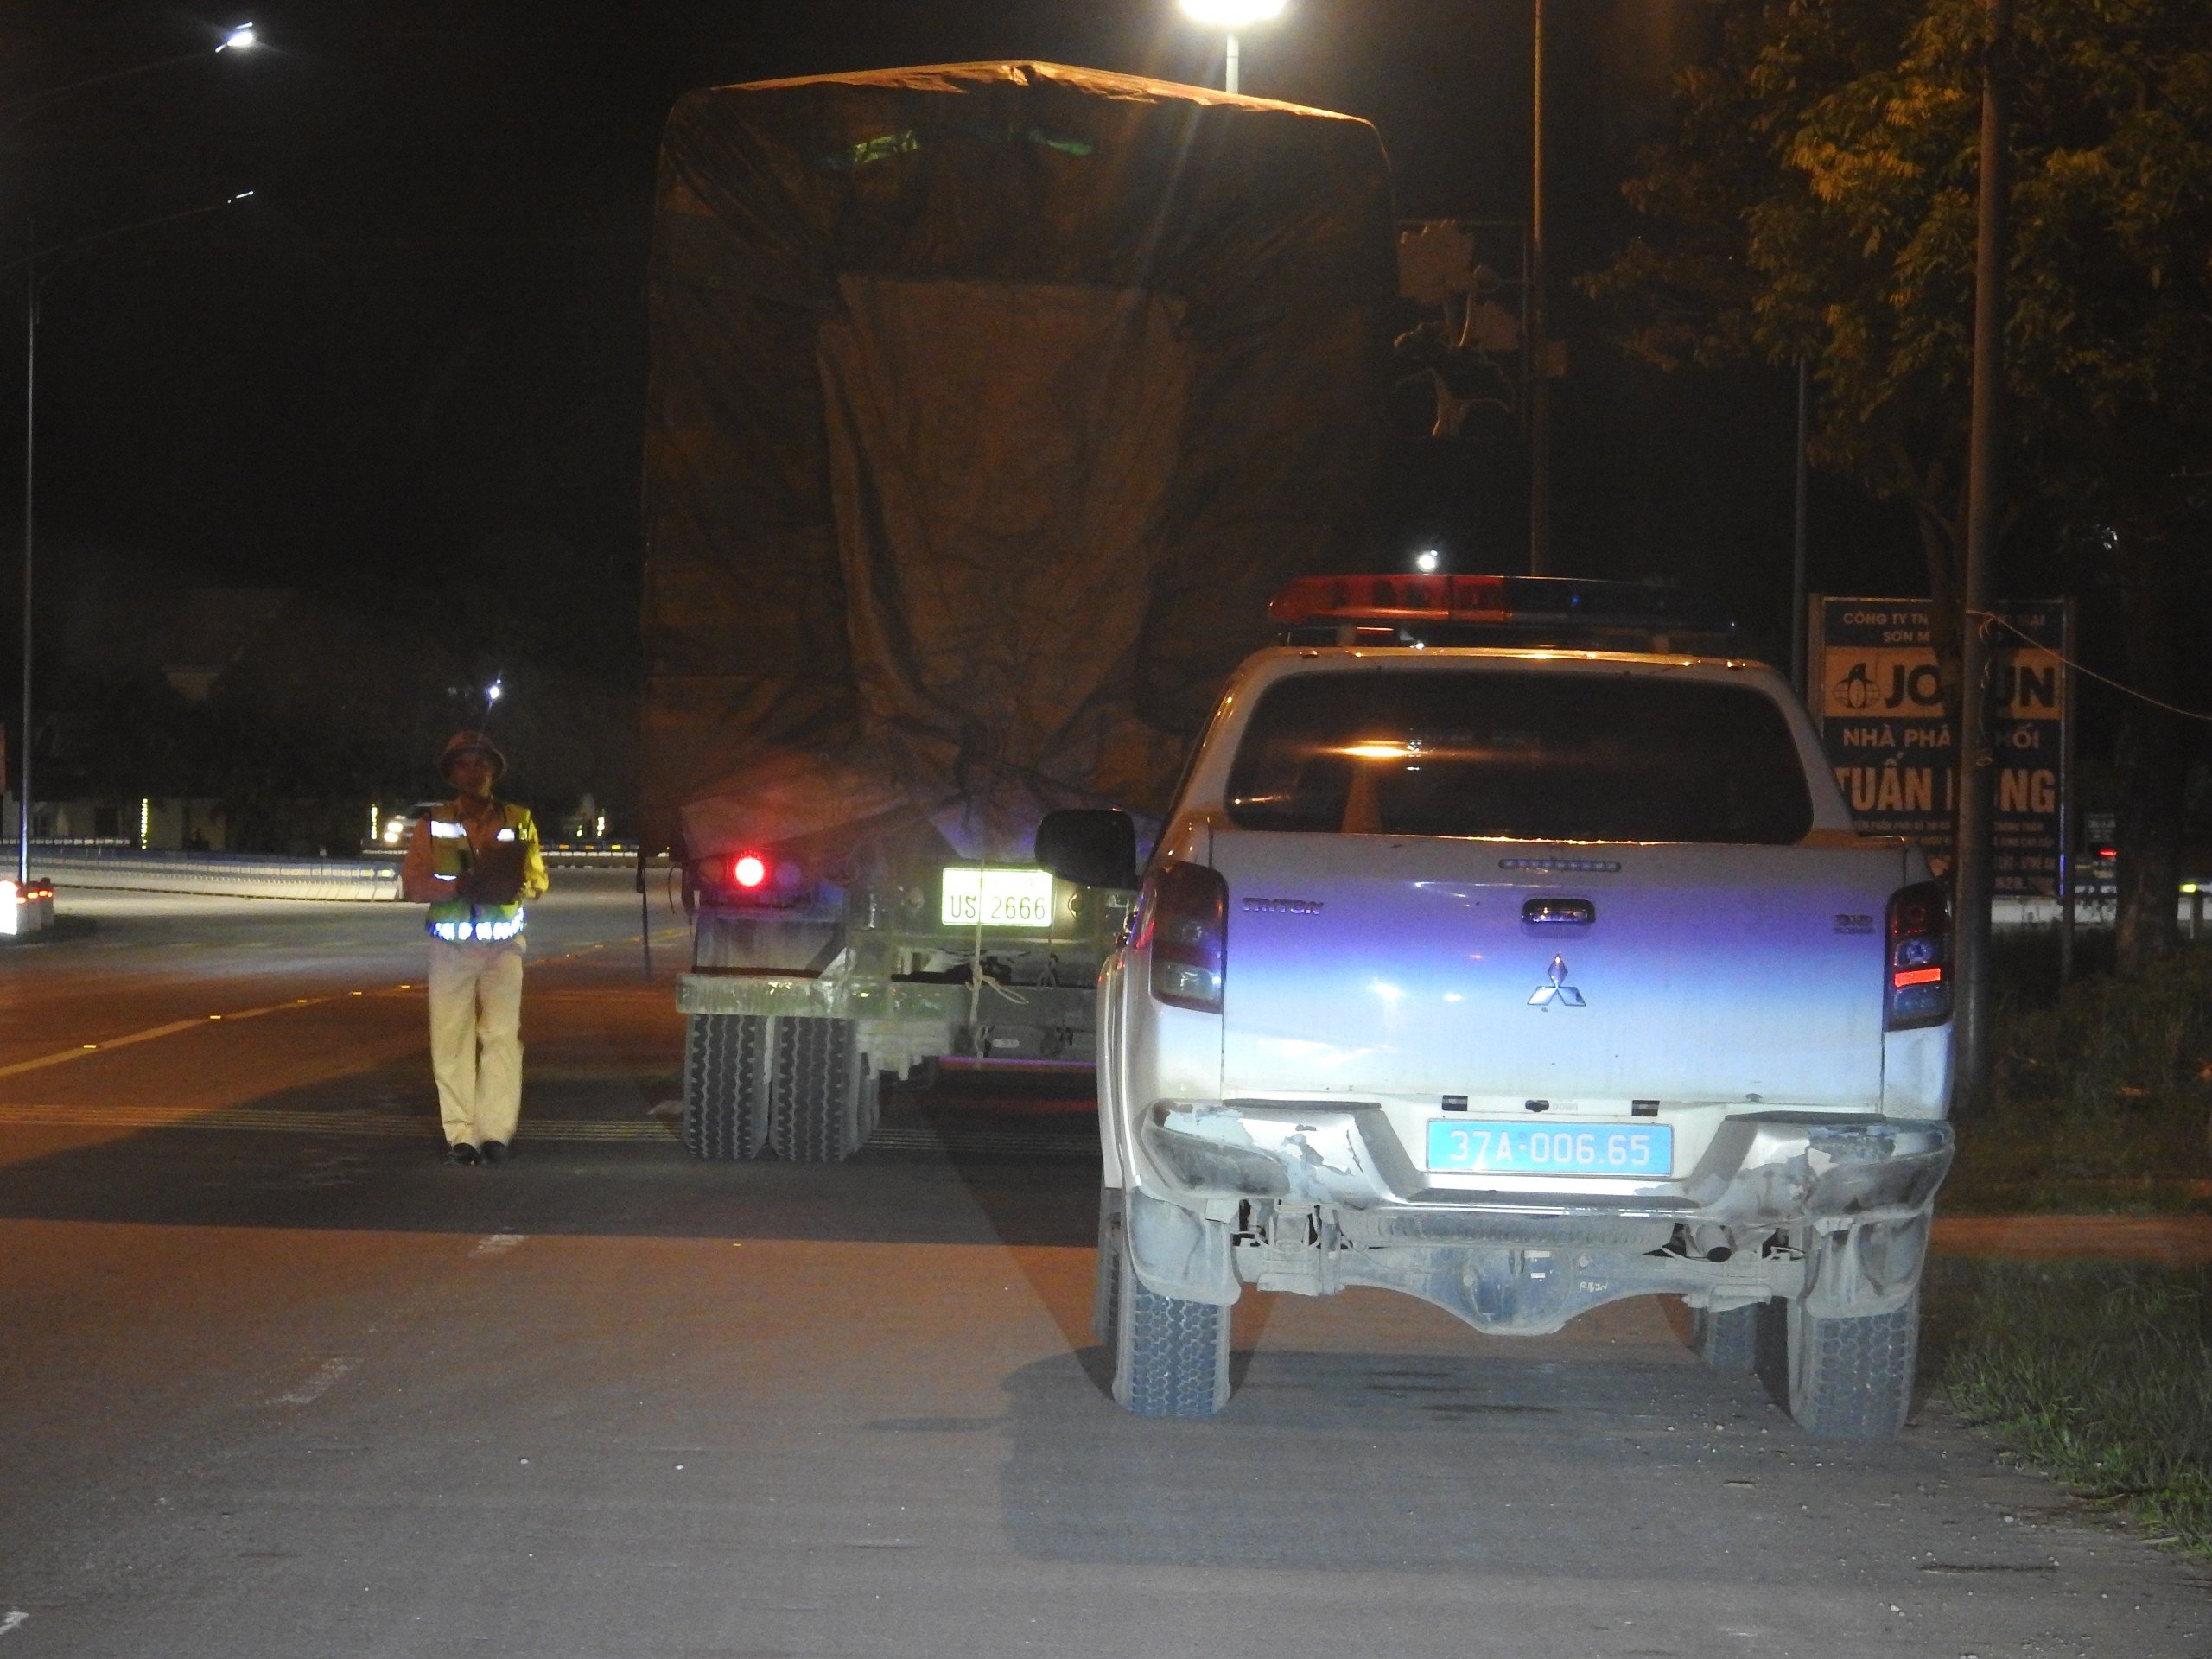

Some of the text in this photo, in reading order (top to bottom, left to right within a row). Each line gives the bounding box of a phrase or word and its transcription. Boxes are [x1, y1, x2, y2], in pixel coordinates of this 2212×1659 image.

[1892, 613, 1907, 624] TY
[1885, 664, 2055, 709] JOUN
[1842, 723, 1896, 747] NHÀ
[1904, 724, 1952, 748] PHÂ
[990, 895, 1046, 920] 2666
[1449, 1130, 1651, 1165] 37A-006.65
